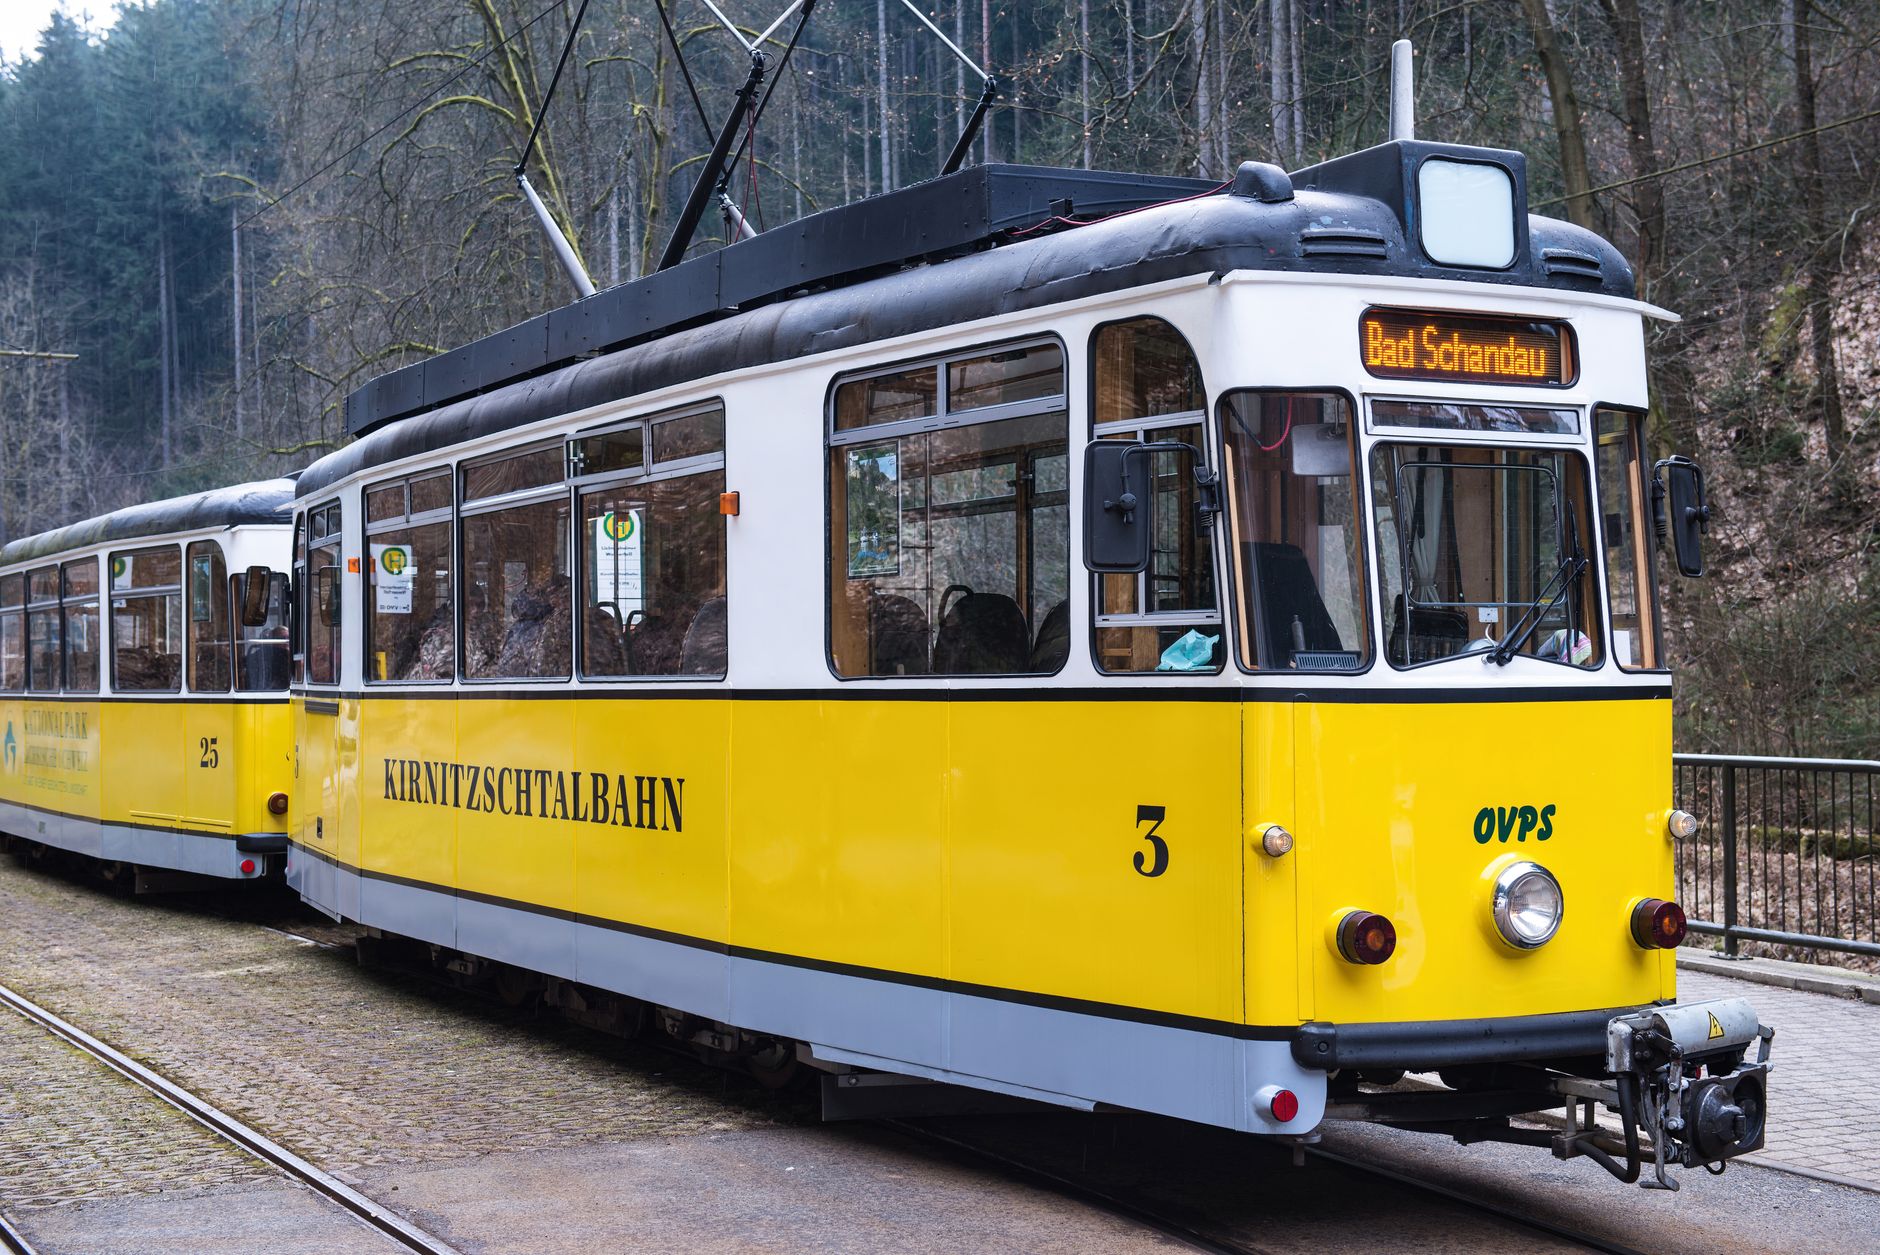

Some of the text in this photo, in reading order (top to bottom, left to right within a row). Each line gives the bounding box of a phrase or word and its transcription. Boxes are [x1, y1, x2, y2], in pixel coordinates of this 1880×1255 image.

[1366, 321, 1546, 377] Bad Schandau
[200, 736, 219, 769] 25
[383, 758, 685, 833] KIRNITZSCHTALBAHN
[1132, 804, 1169, 878] 3
[1473, 804, 1557, 845] OVPS
